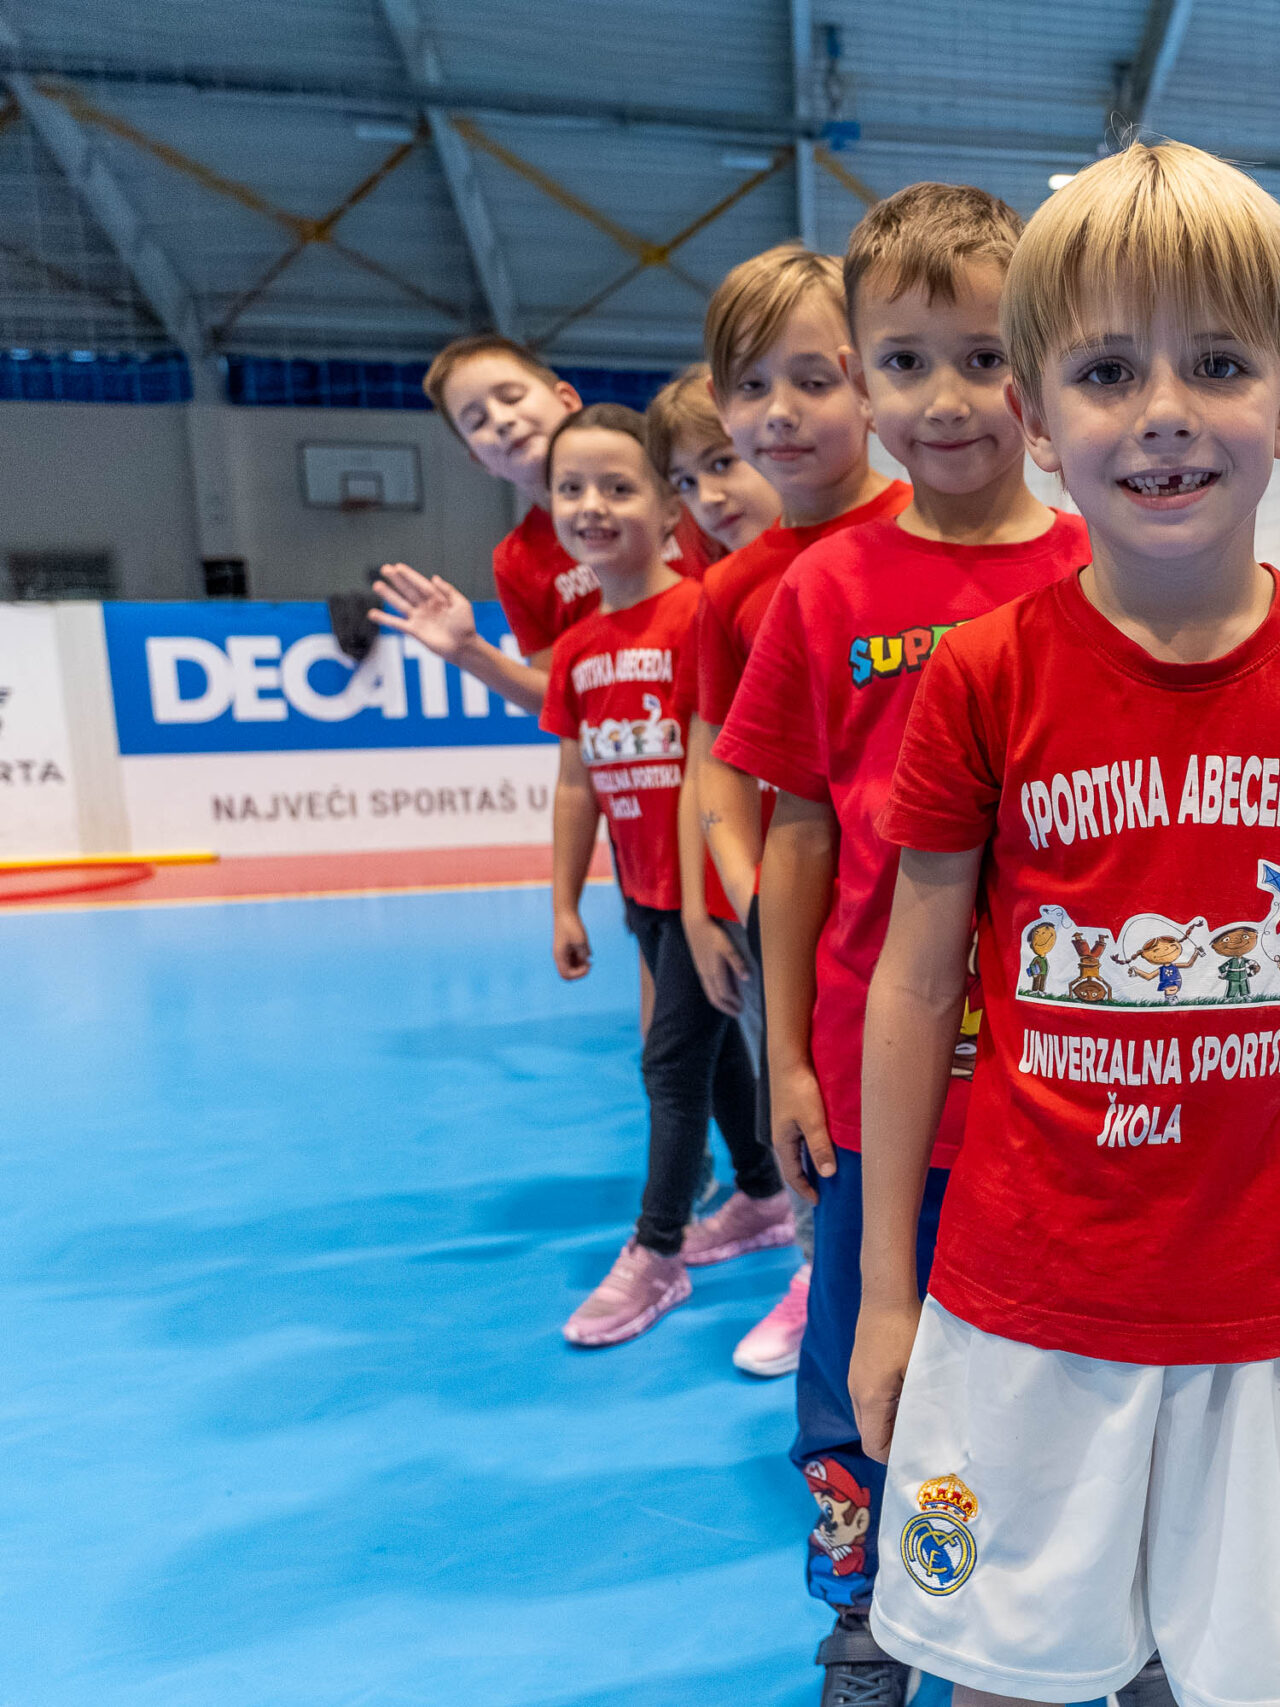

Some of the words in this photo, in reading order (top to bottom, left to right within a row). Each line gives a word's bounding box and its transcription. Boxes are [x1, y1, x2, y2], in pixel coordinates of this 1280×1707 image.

[849, 617, 974, 690] SUP
[211, 783, 357, 821] NAJVEĆI
[371, 777, 517, 817] SPORTAŠ
[1021, 756, 1170, 850] SPORTSKA
[1018, 1029, 1182, 1086] UNIVERZALNA
[1097, 1091, 1182, 1147] ŠKOLA
